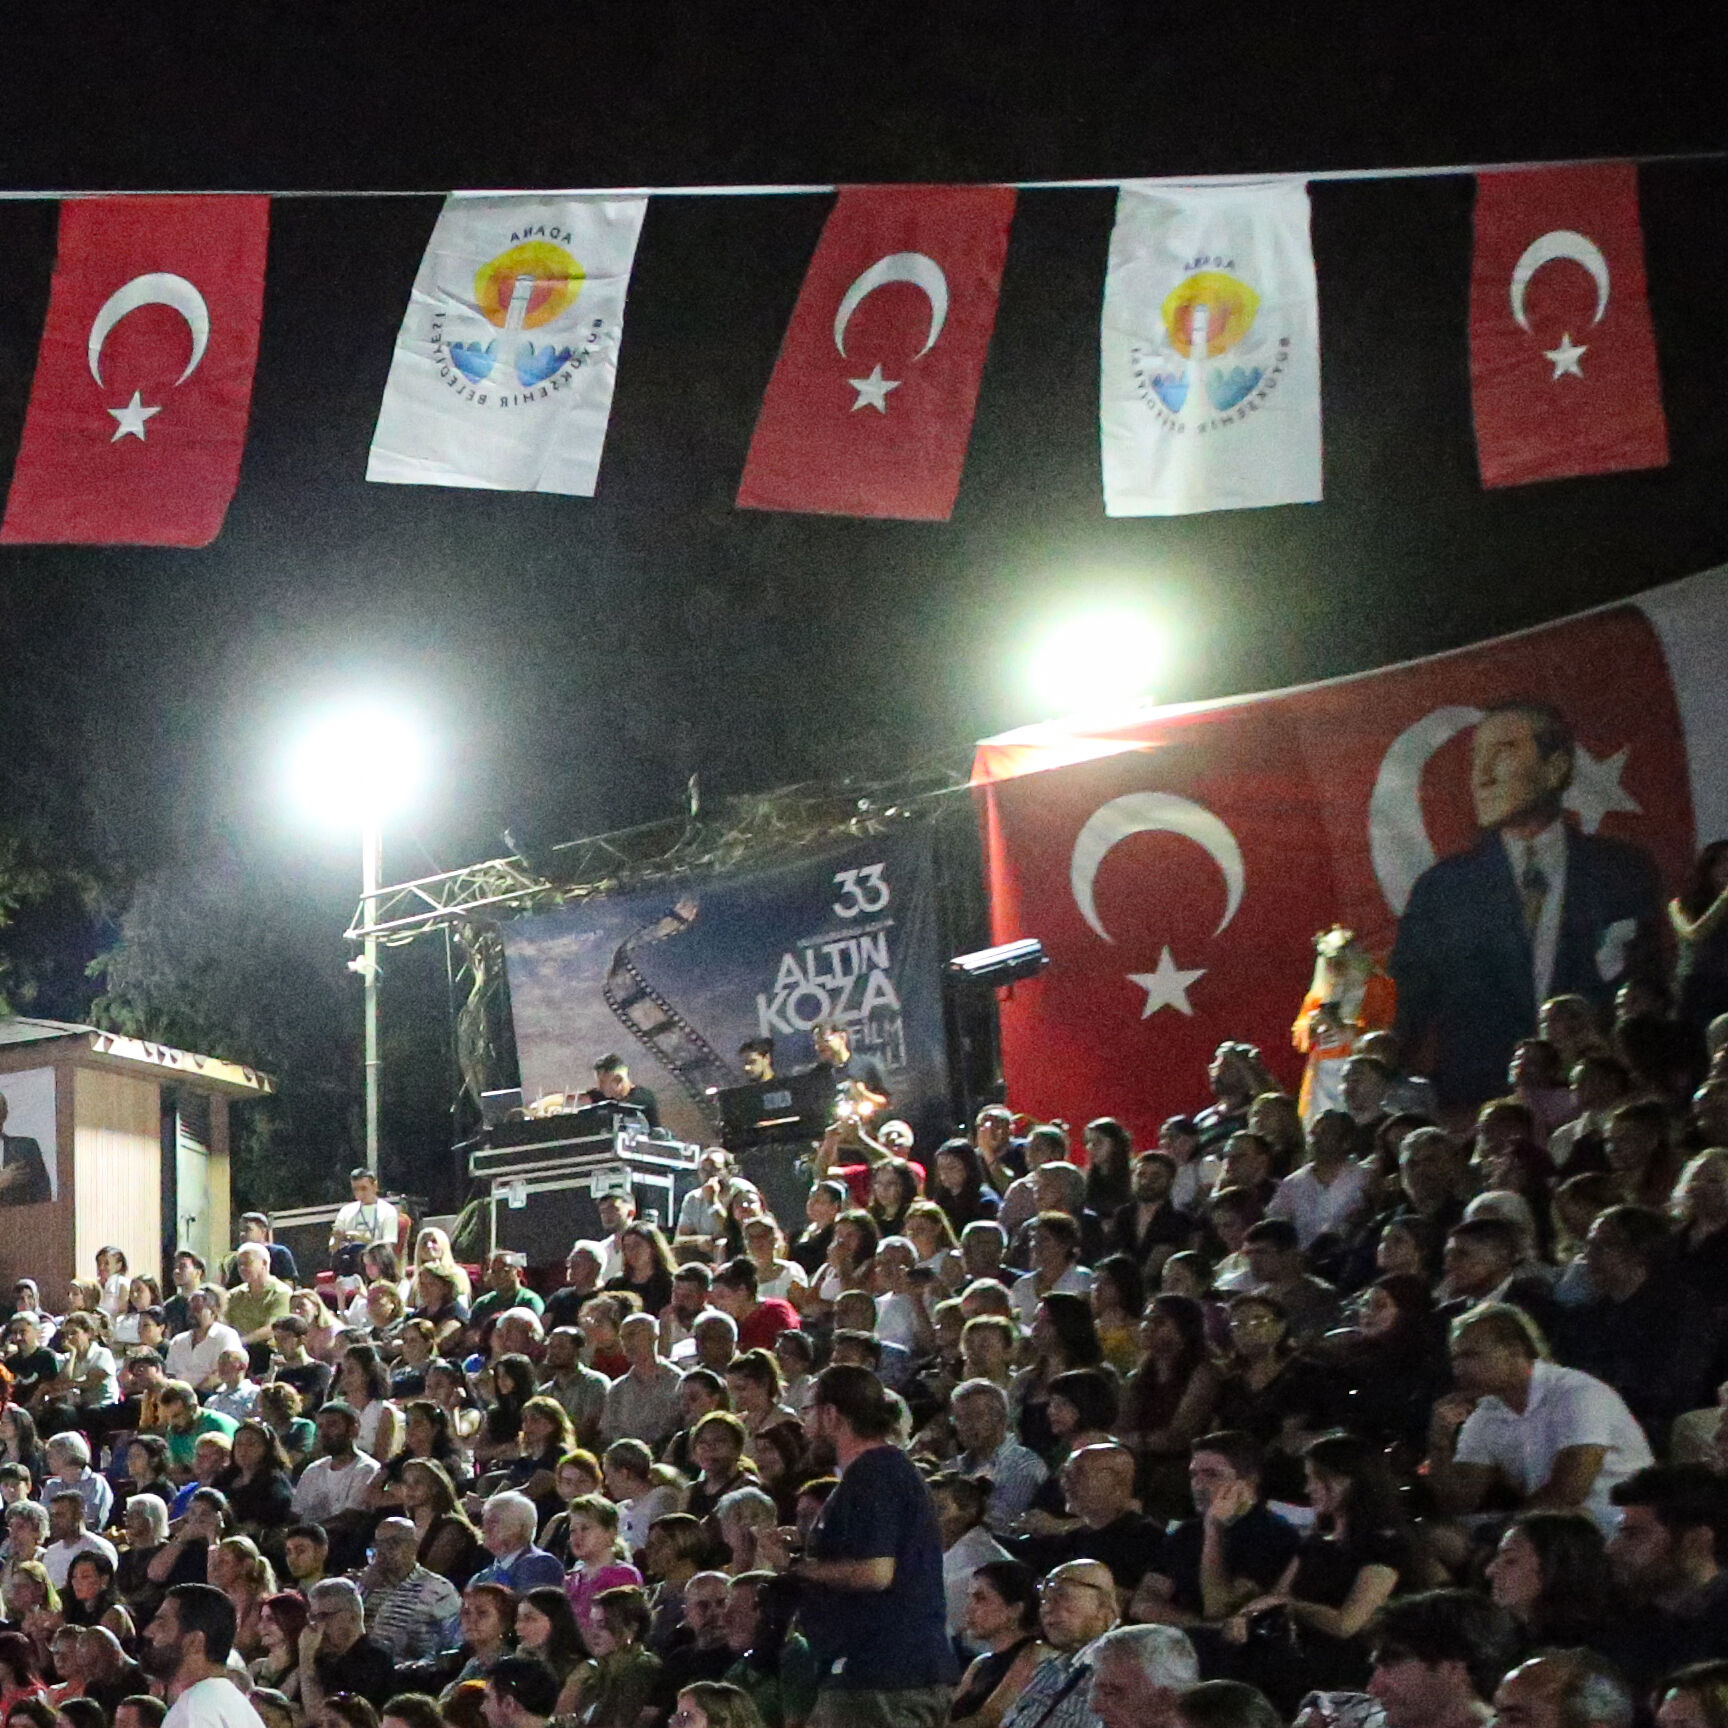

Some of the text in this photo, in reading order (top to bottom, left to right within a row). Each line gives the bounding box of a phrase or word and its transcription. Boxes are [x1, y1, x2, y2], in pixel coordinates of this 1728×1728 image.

[833, 864, 890, 918] 33
[774, 931, 890, 992] ALTIN
[756, 970, 902, 1038] KOZA
